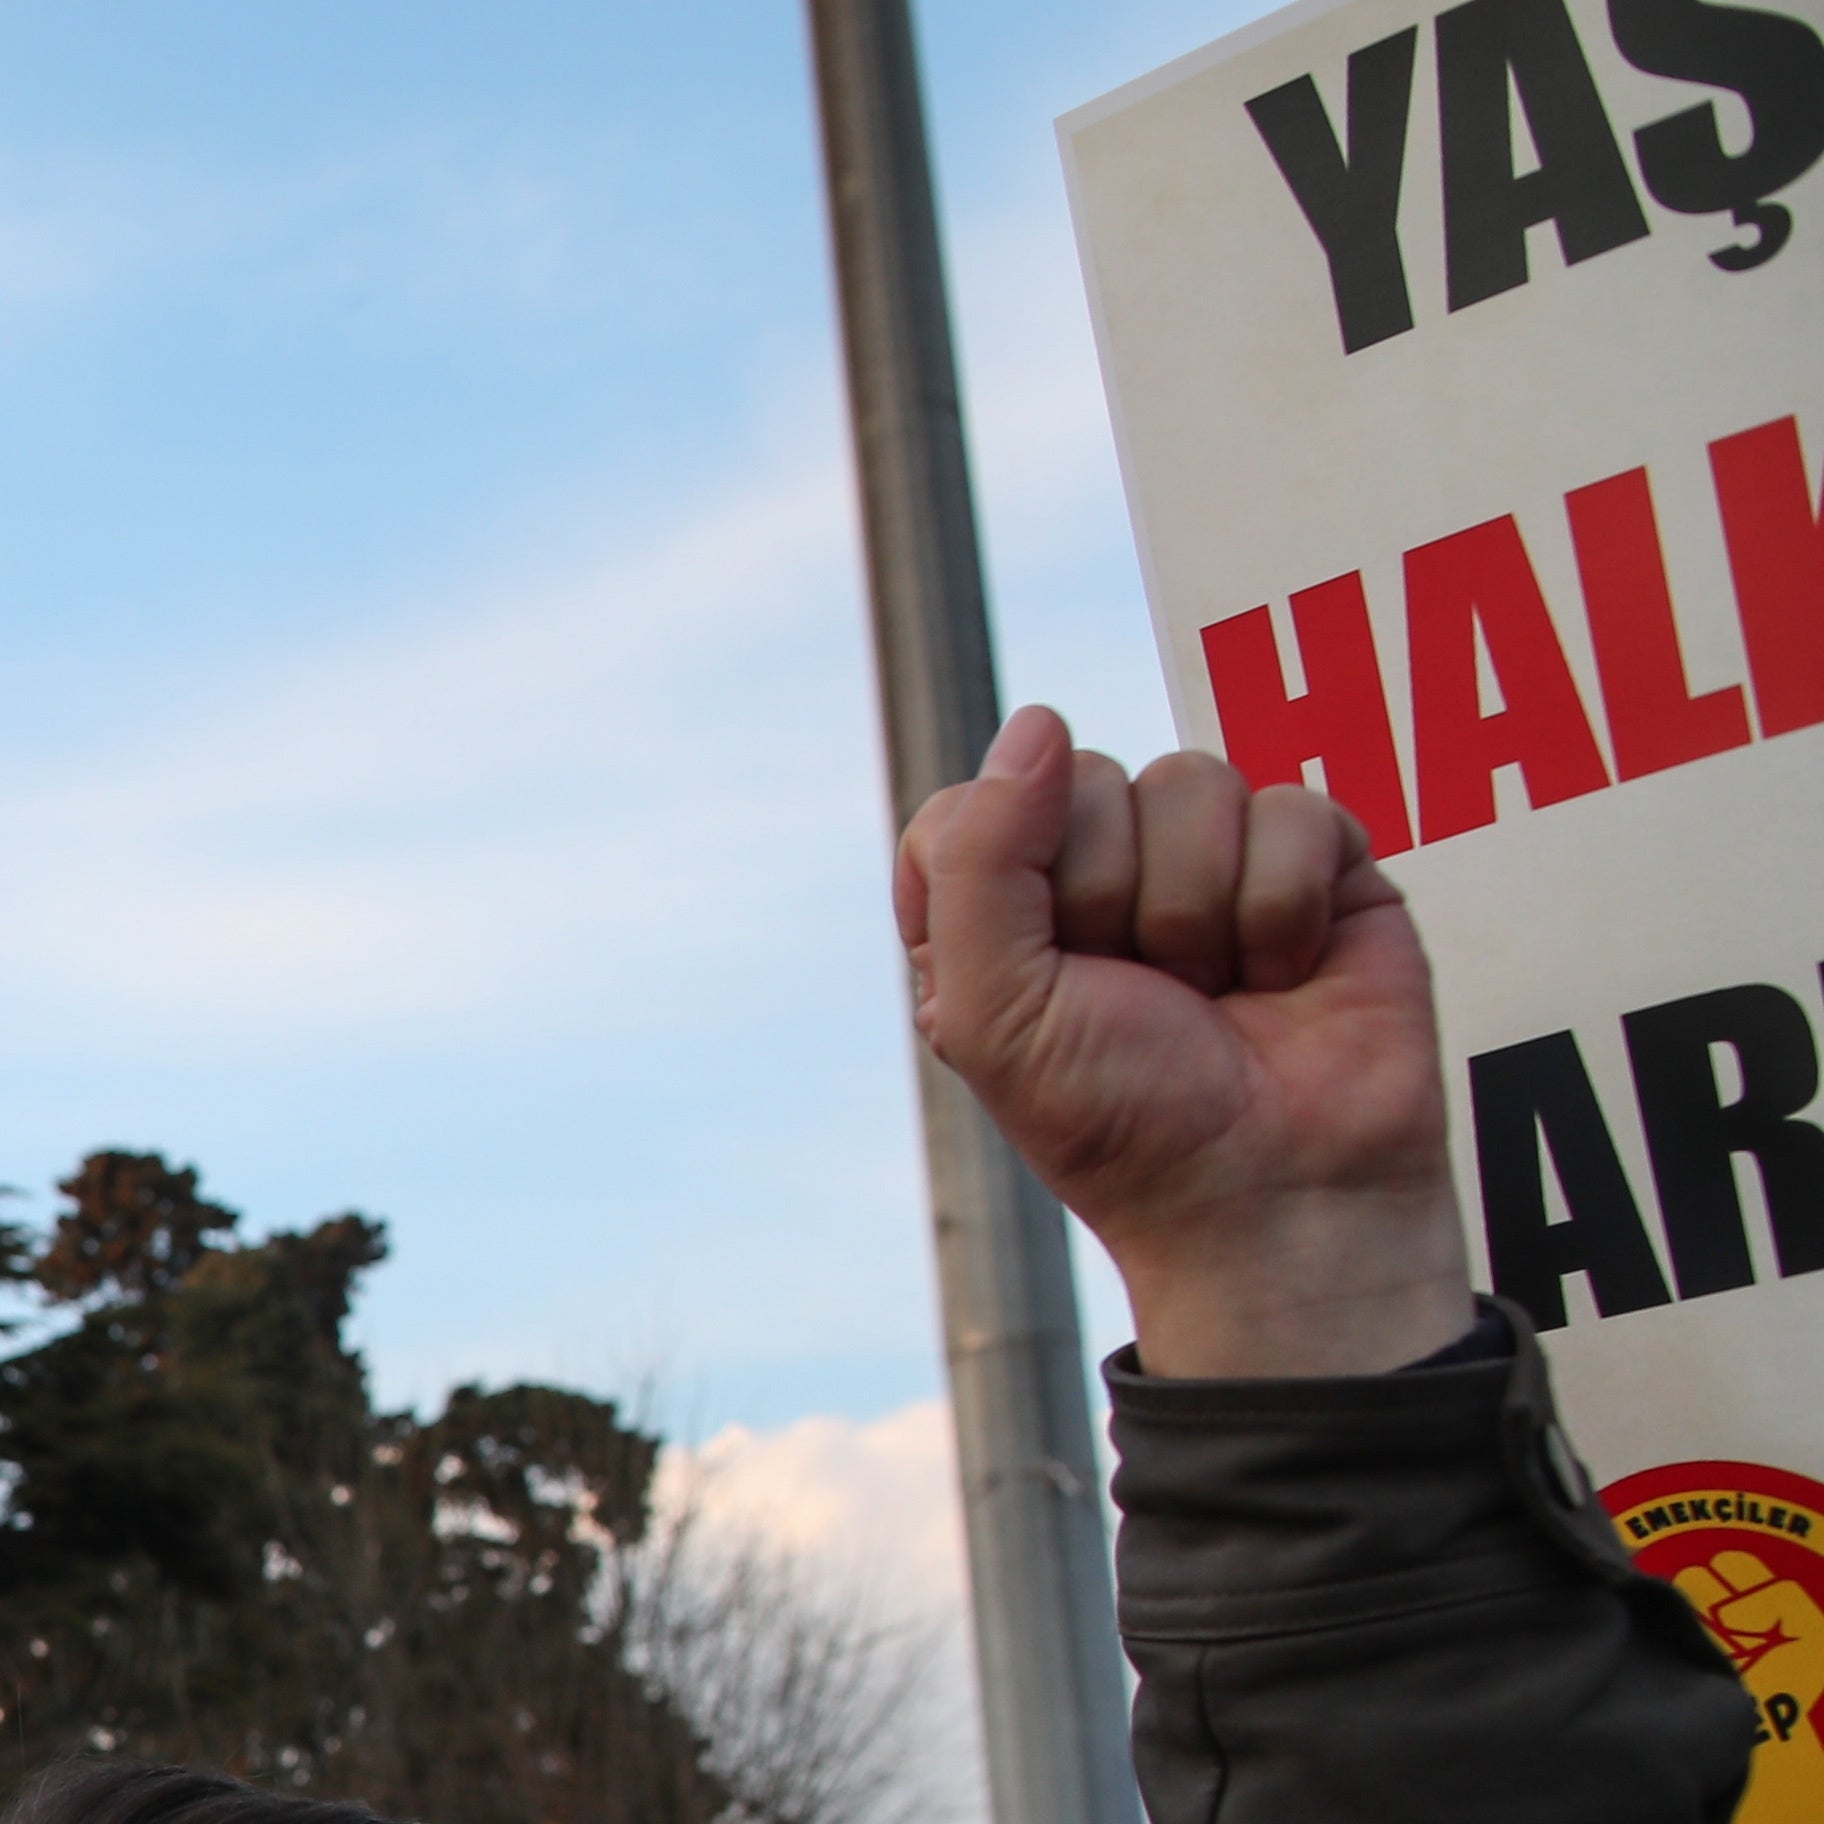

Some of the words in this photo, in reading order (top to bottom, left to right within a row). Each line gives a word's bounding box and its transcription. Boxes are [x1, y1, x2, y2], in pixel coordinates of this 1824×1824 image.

[1244, 0, 1824, 356] YAŞ
[1467, 960, 1824, 1334] AR
[1624, 1493, 1813, 1541] EMEKÇİLER
